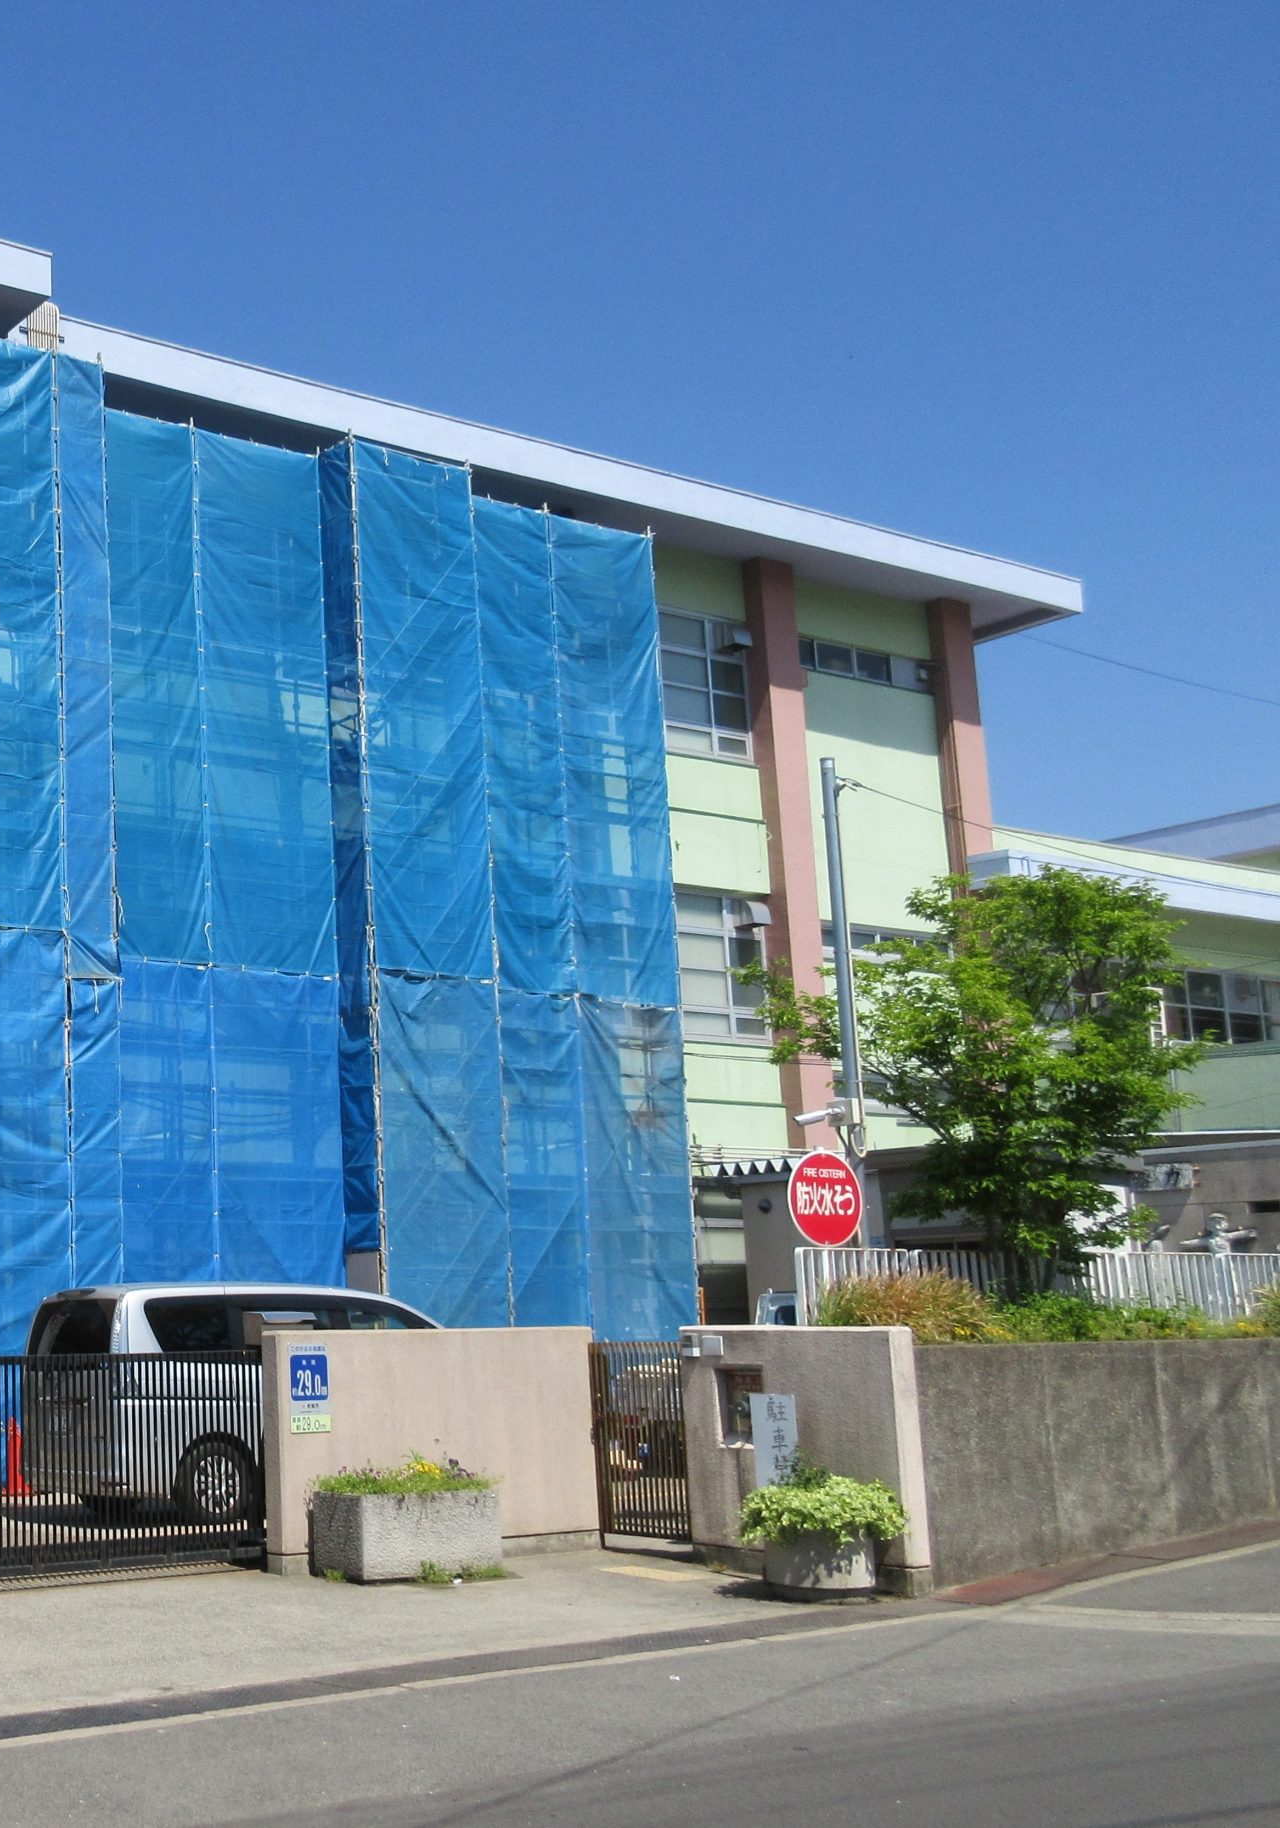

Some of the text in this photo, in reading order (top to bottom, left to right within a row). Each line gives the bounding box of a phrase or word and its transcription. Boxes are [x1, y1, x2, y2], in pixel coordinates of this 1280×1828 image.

[803, 1167, 818, 1178] FIRE
[796, 1181, 855, 1216] 防火水そう
